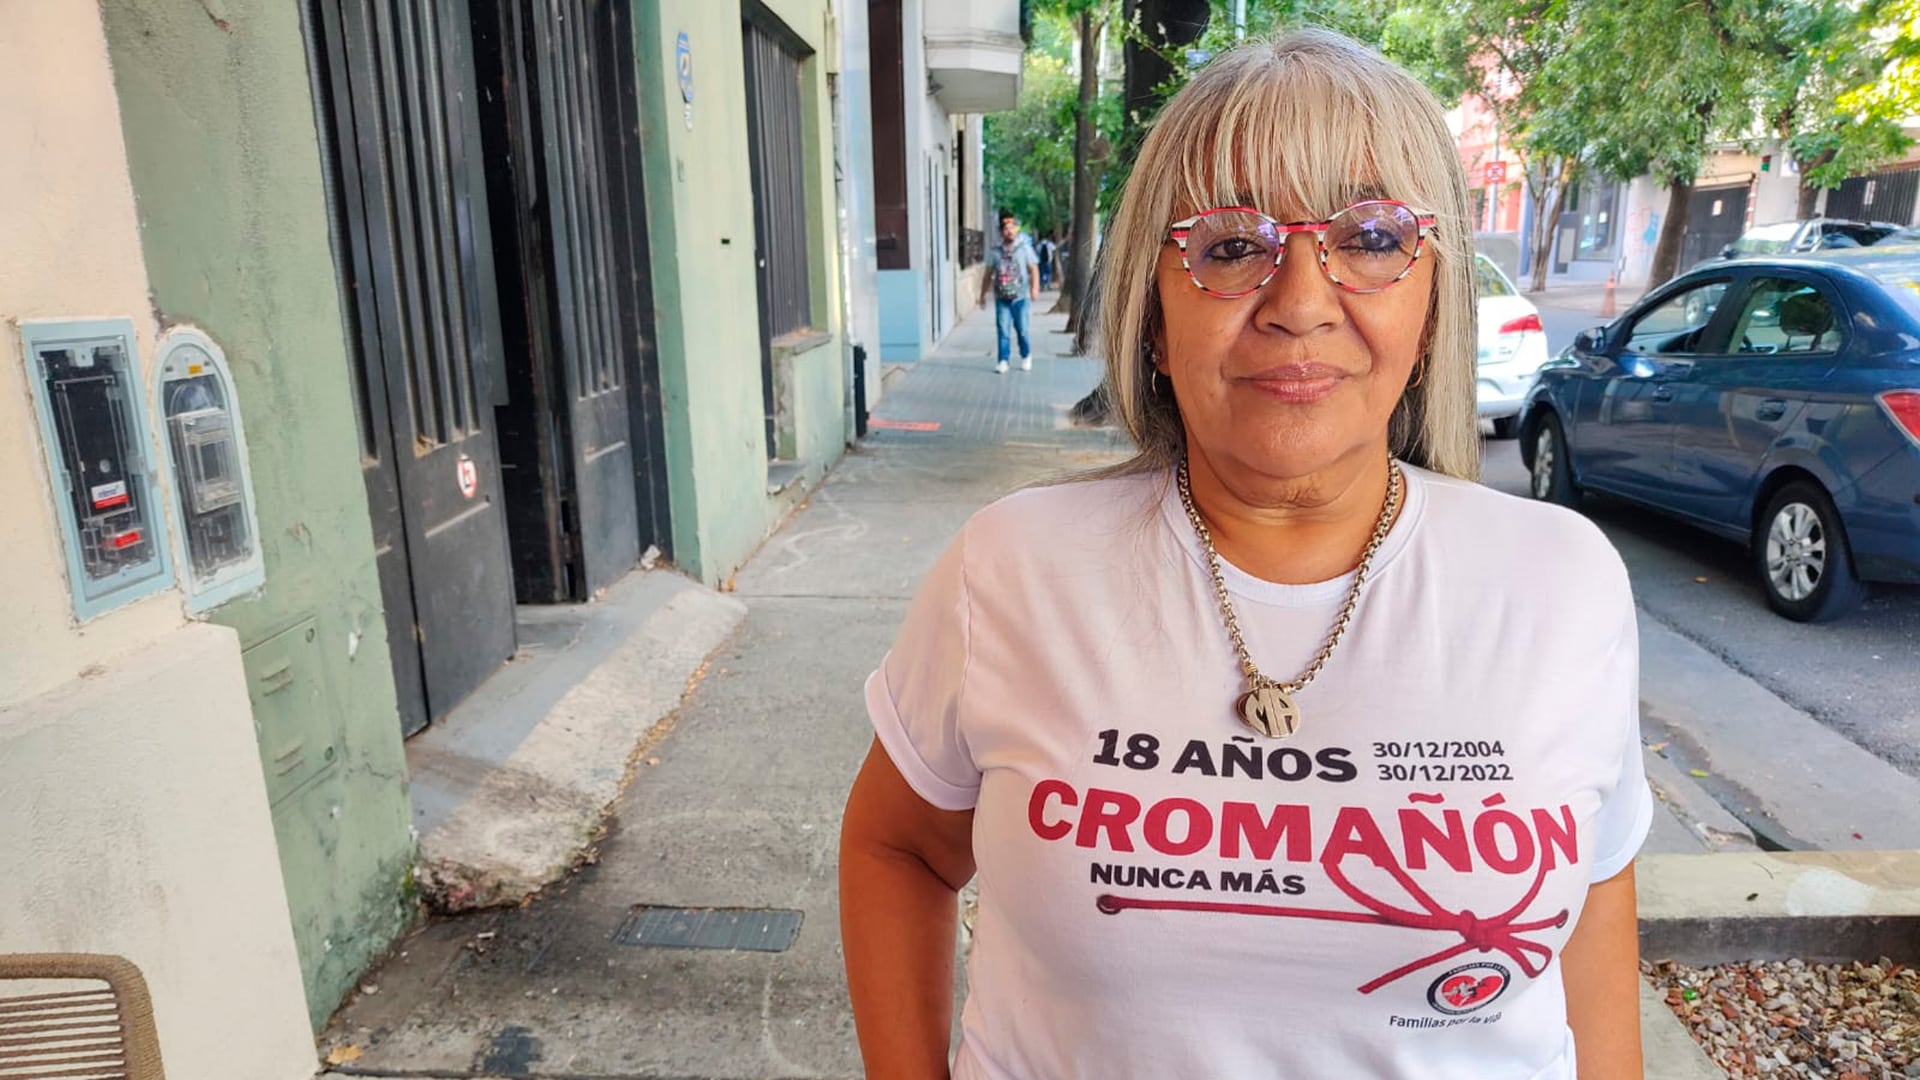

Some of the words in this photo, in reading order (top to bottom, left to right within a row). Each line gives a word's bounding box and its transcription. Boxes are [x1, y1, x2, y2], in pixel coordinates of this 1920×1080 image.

[1094, 729, 1160, 768] 18
[1172, 737, 1358, 782] AÑOS
[1373, 740, 1505, 758] 30/12/2004
[1377, 764, 1514, 781] 30/12/2022
[1029, 779, 1578, 875] CROMAÑÓN
[1090, 863, 1211, 890] NUNCA
[1221, 869, 1306, 895] MÁS
[1389, 1015, 1445, 1029] Familias
[1446, 1017, 1468, 1028] por
